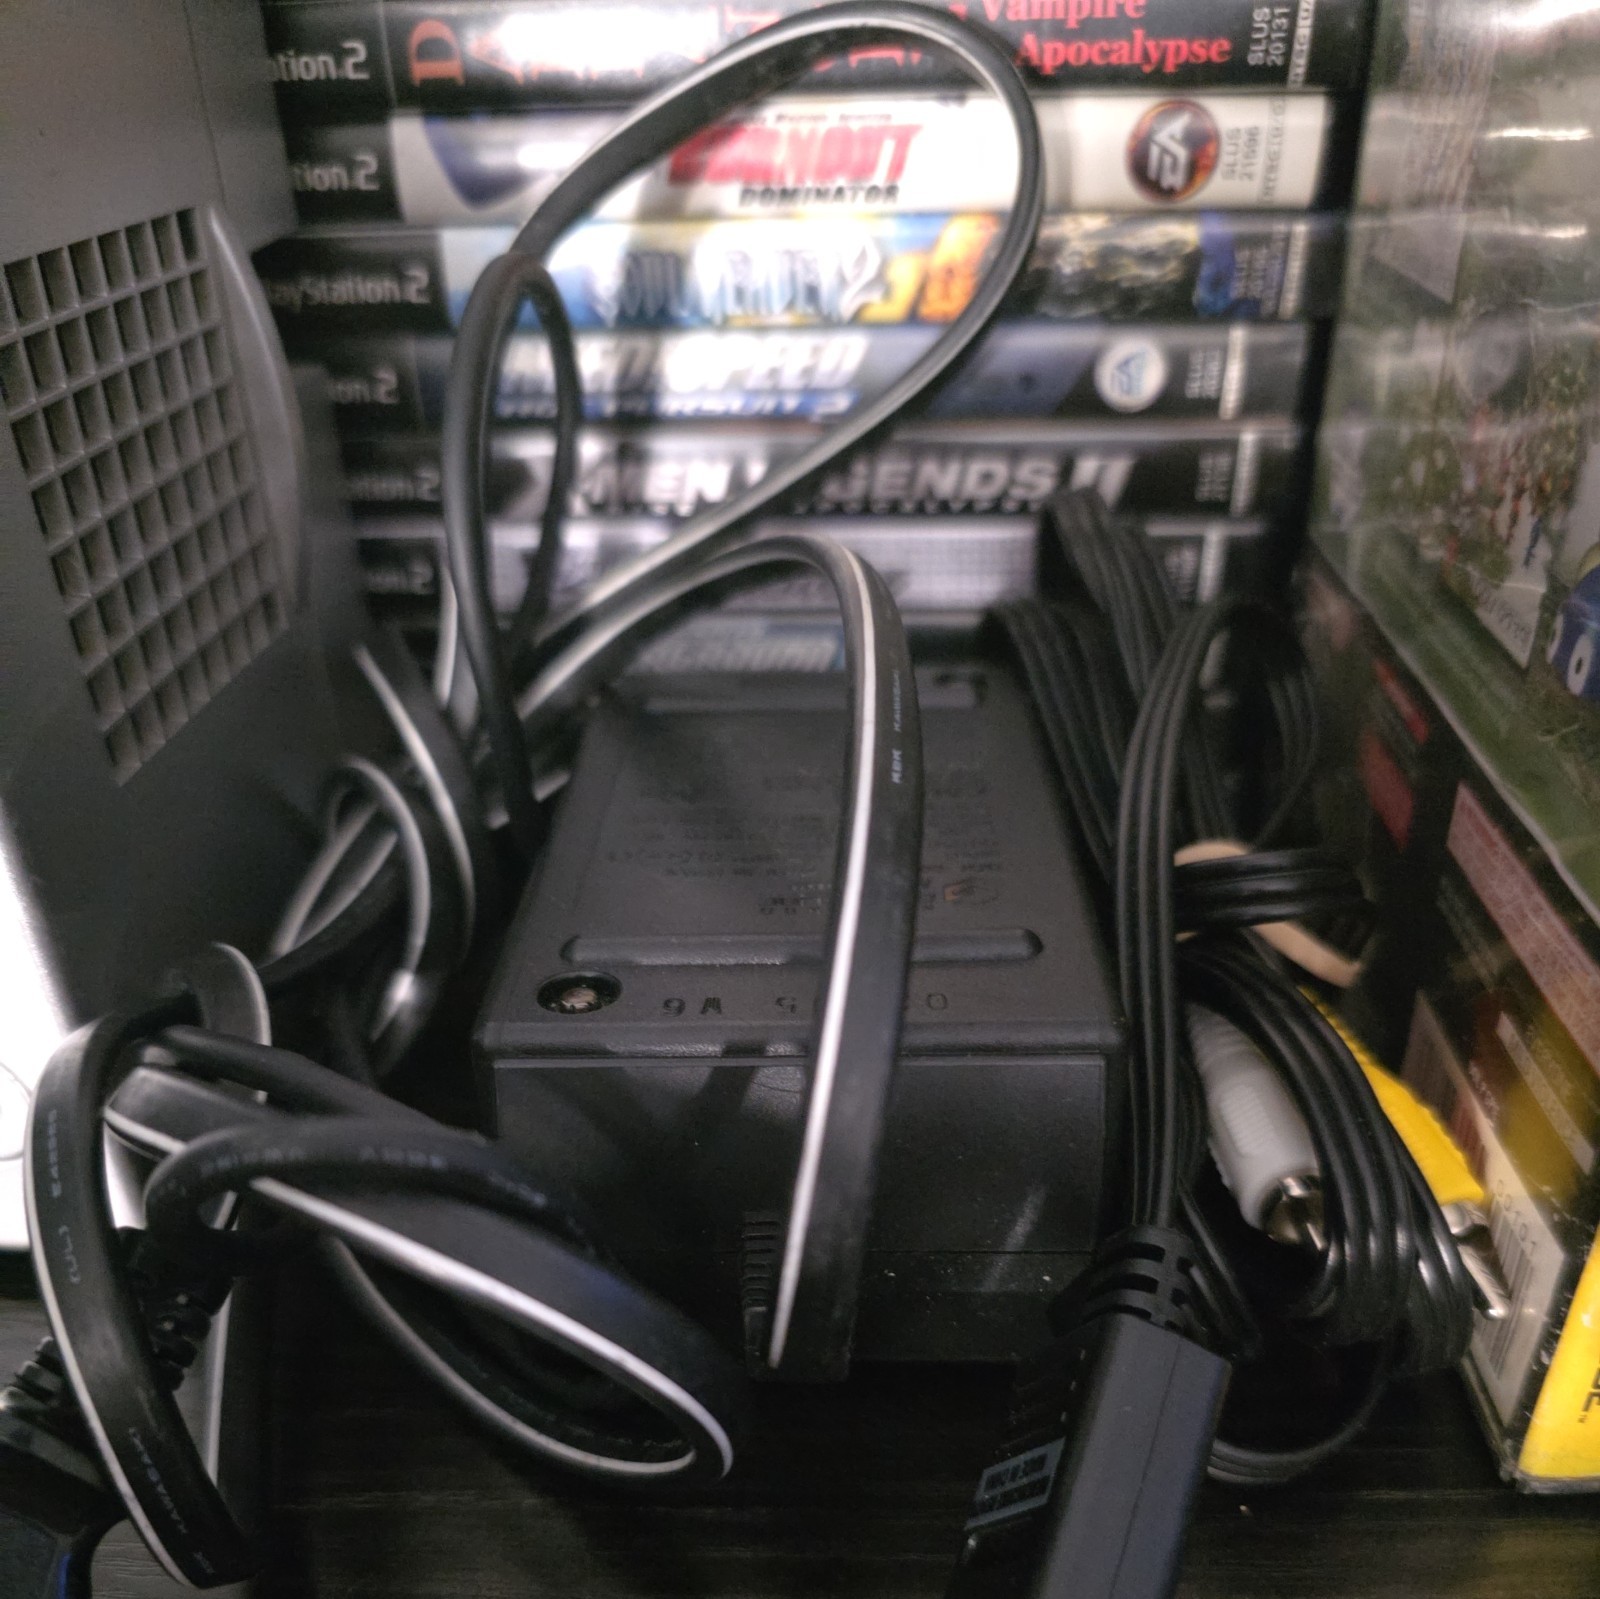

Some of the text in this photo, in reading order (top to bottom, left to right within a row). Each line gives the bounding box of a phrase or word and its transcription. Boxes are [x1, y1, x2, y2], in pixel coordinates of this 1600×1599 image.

[341, 38, 371, 80] 2
[1015, 28, 1232, 76] Apocalypse
[1247, 7, 1271, 66] SLUS
[1266, 7, 1291, 67] 20131
[353, 152, 379, 191] 2
[1222, 127, 1241, 180] SLUS
[738, 184, 900, 207] DOMINATOR
[402, 269, 430, 304] 2
